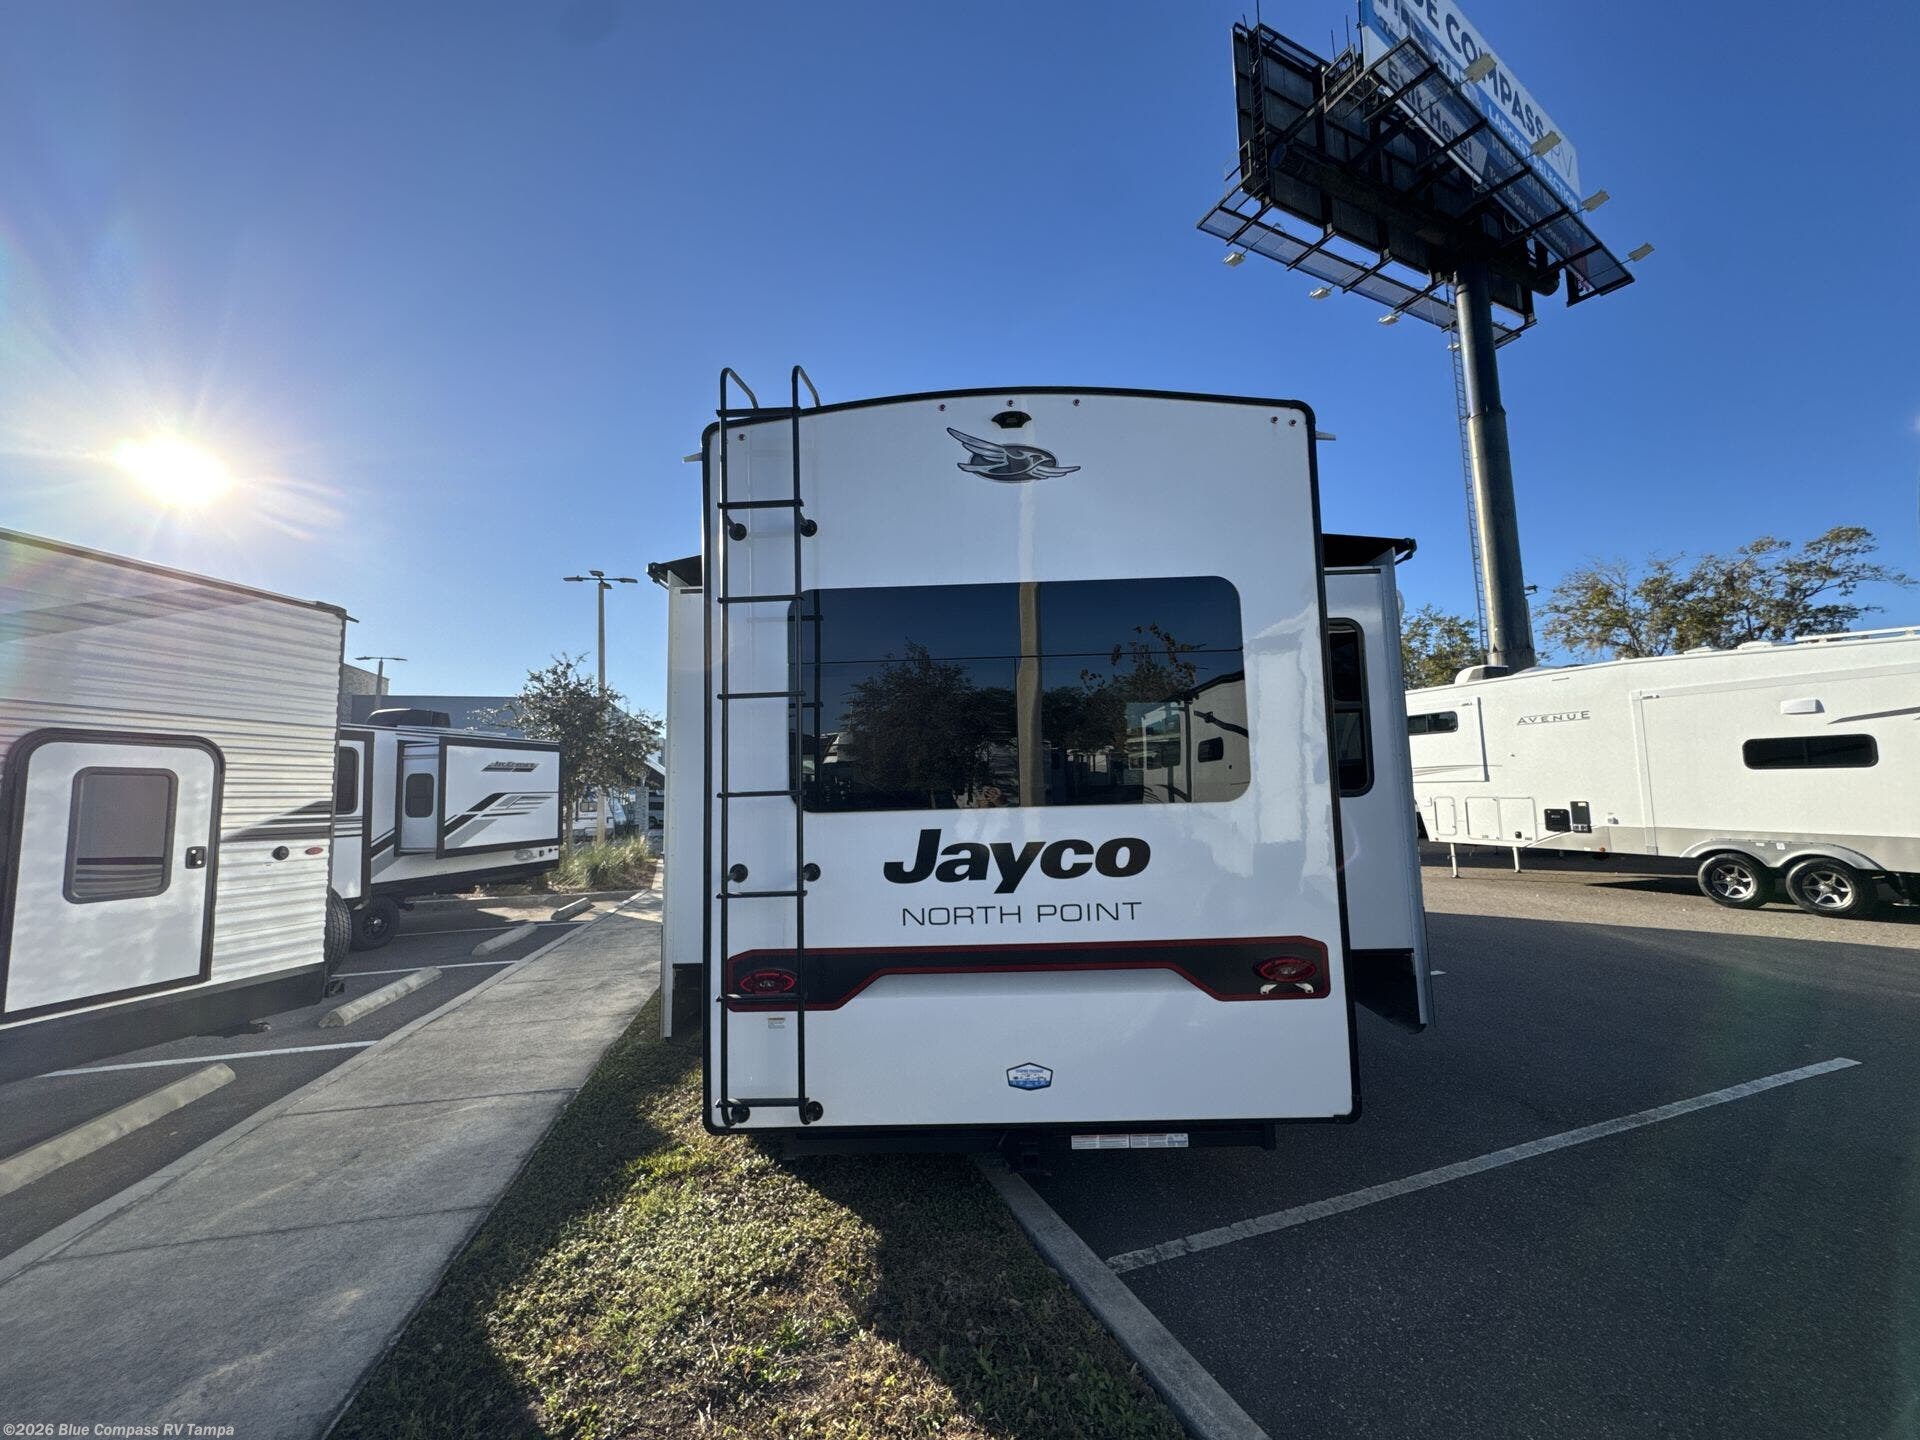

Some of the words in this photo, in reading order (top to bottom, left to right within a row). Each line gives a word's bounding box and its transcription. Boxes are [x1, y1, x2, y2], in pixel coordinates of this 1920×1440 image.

[1517, 710, 1590, 726] AVENUE
[883, 828, 1151, 894] Jayco
[902, 905, 1021, 926] NORTH
[1037, 902, 1142, 923] POINT
